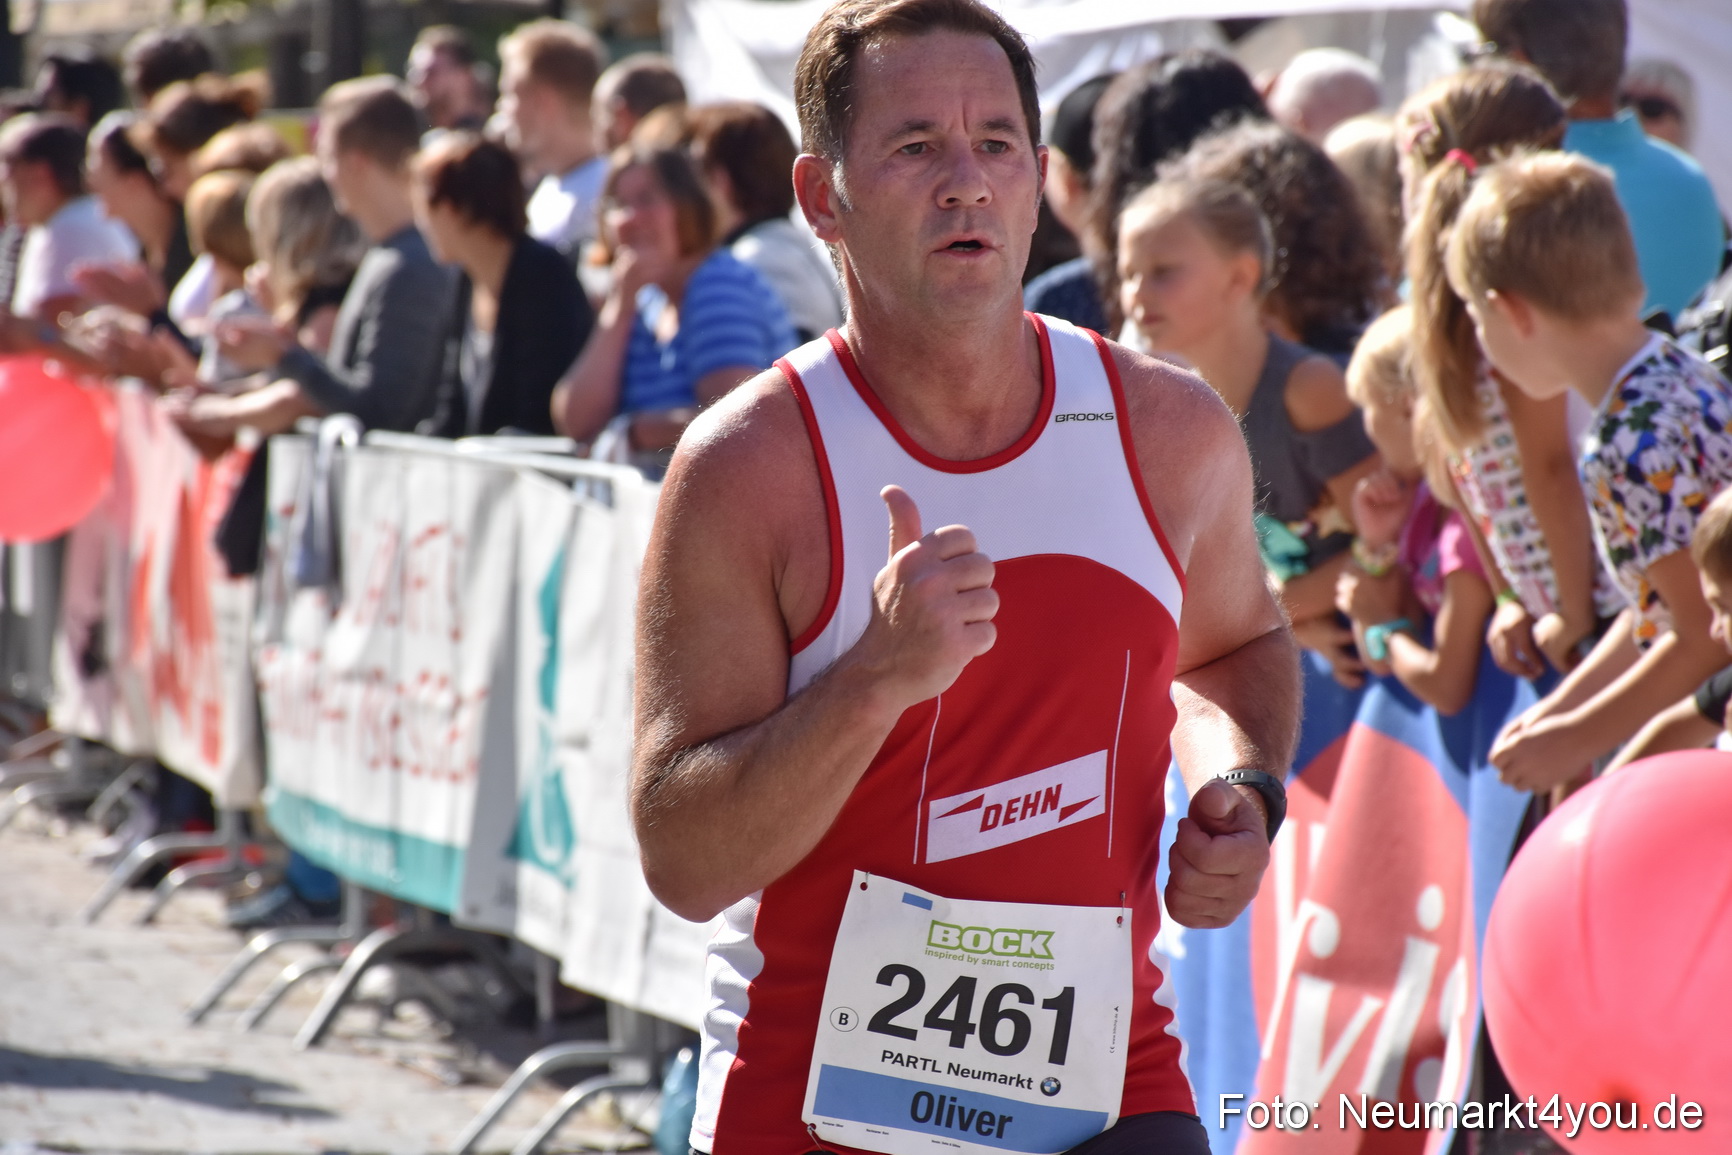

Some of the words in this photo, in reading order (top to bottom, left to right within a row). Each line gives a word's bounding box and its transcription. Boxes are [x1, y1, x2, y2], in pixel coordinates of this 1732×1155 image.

[1055, 412, 1114, 422] BROOKS
[979, 784, 1061, 832] DEHN
[925, 948, 965, 962] inspired
[967, 956, 979, 965] by
[981, 958, 1010, 967] smart
[1012, 961, 1055, 971] concepts
[927, 920, 1055, 959] BOCK
[839, 1012, 849, 1026] B
[867, 964, 1074, 1066] 2461
[881, 1049, 942, 1073] PARTL
[947, 1062, 1034, 1090] Neumarkt
[911, 1090, 1013, 1139] Oliver
